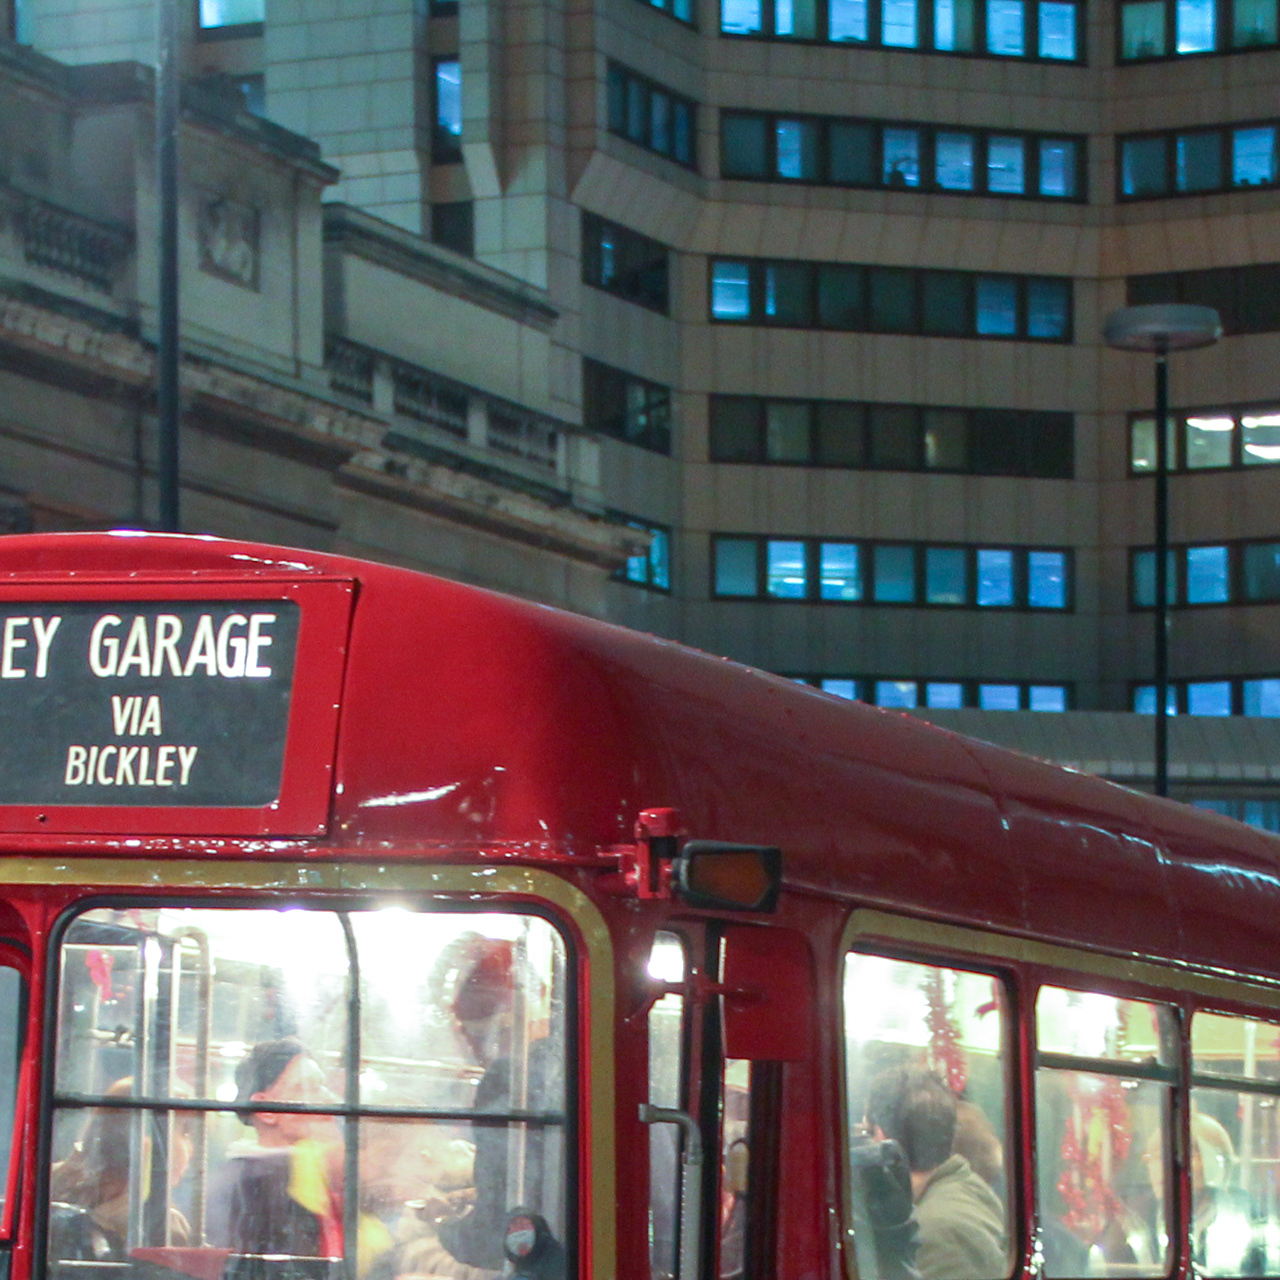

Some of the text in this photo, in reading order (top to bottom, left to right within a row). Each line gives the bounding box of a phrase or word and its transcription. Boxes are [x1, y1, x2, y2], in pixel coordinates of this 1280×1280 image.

[89, 614, 277, 677] GARAGE
[111, 695, 162, 736] VIA
[64, 745, 198, 786] BICKLEY
